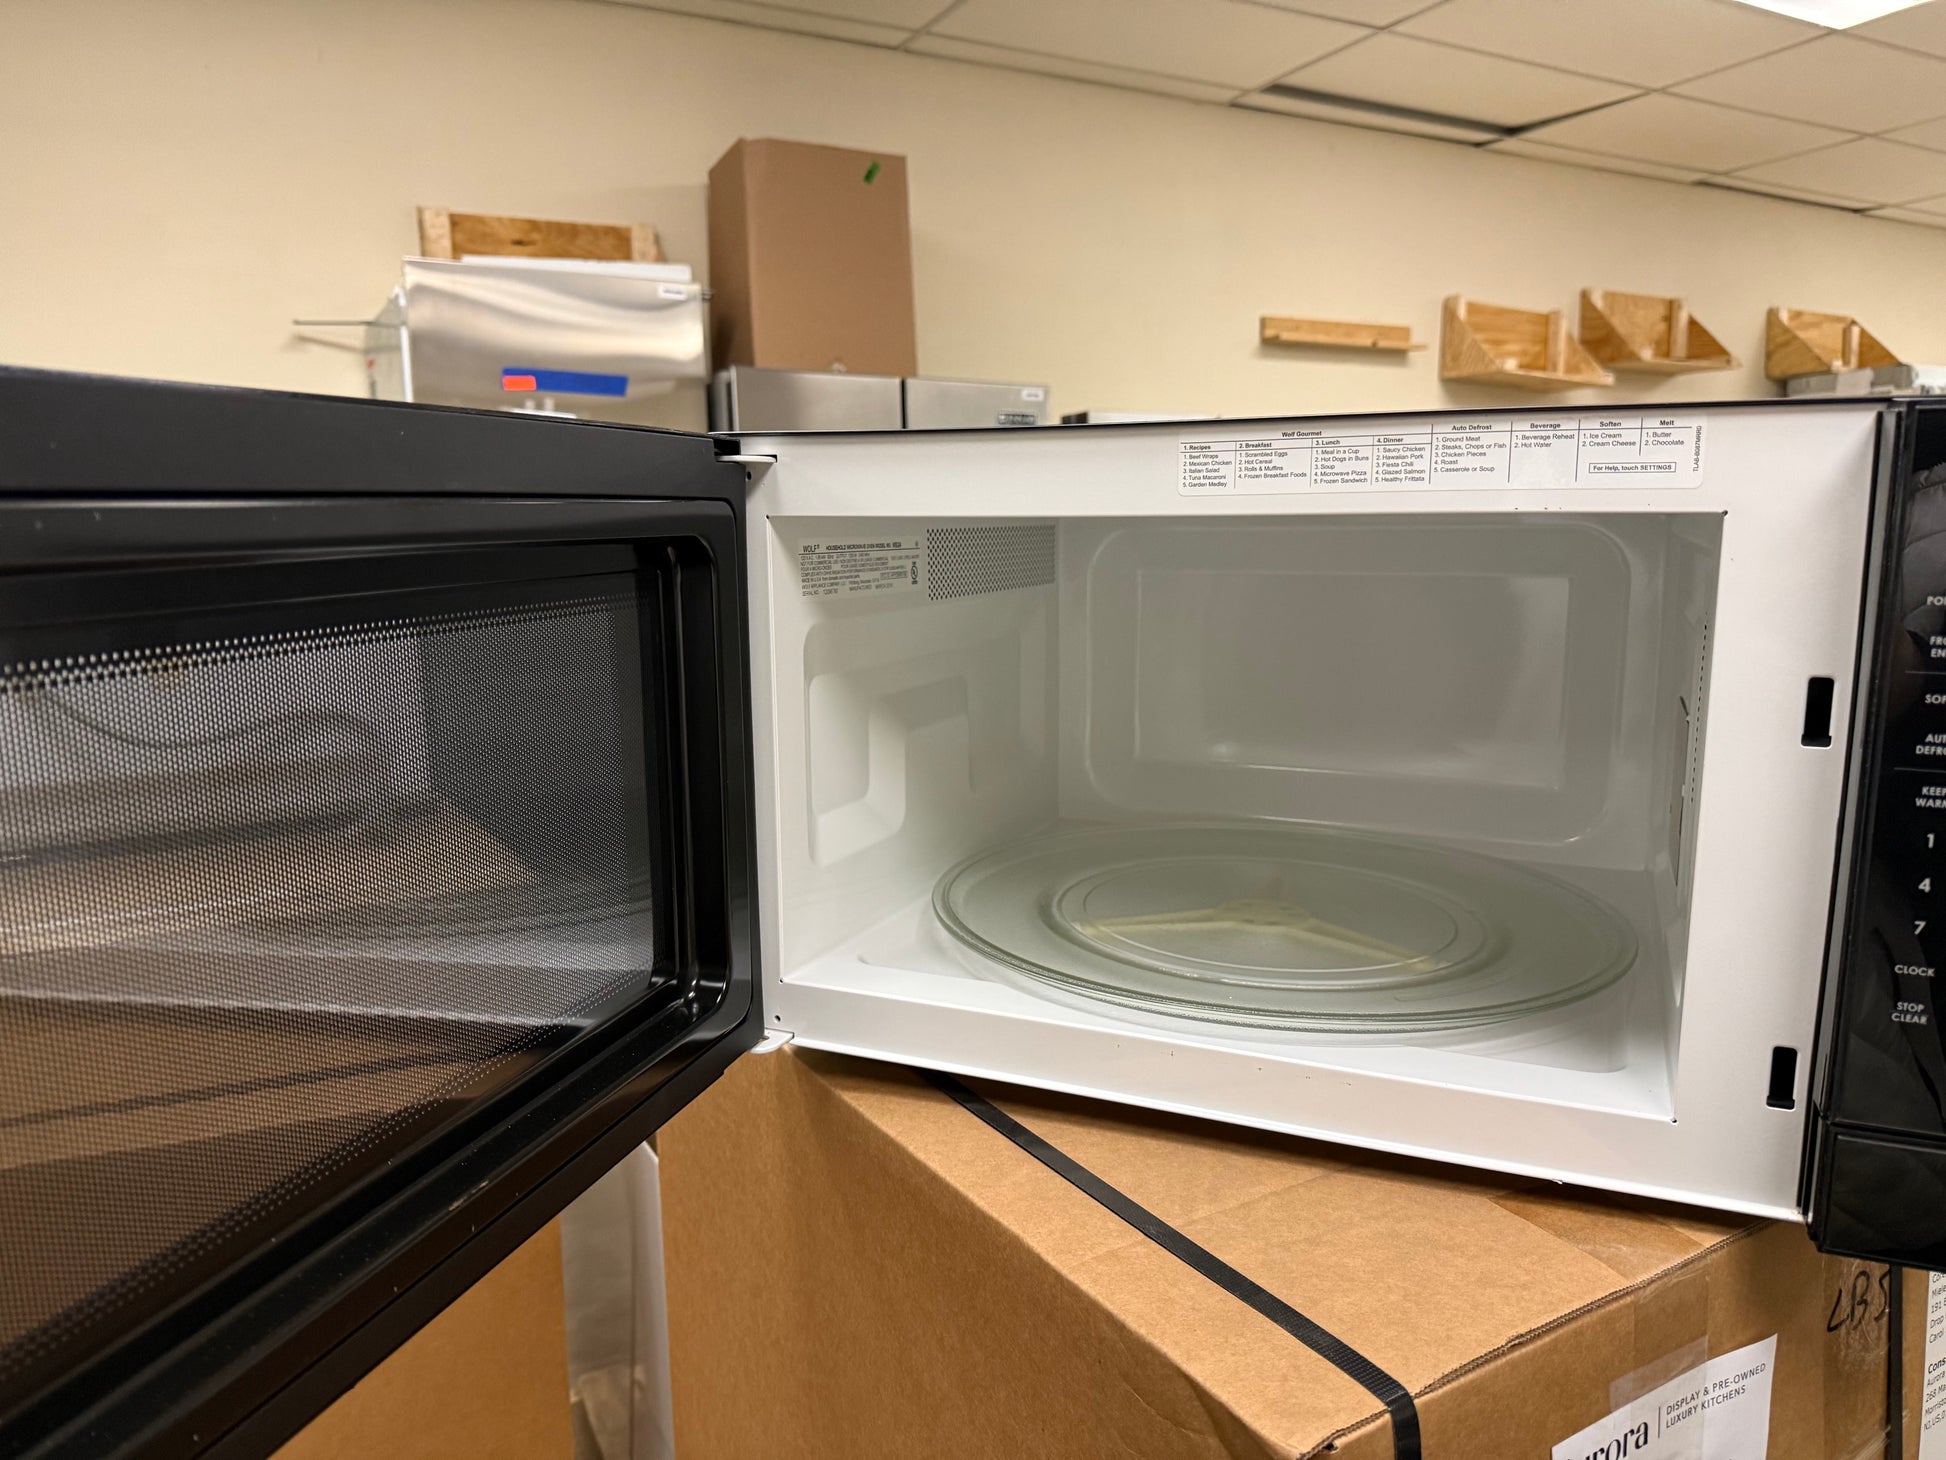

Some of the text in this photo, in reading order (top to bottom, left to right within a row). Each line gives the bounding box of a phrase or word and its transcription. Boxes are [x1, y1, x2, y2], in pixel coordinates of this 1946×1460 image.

[1927, 595, 1946, 606] PO
[1927, 833, 1935, 848] 1
[1918, 878, 1931, 893] 4
[1914, 920, 1926, 935] 7
[1894, 964, 1936, 977] CLOCK
[1896, 1001, 1925, 1013] STOP
[1891, 1012, 1928, 1024] CLEAR
[1667, 1363, 1766, 1415] DISPLAY & PRE-OWNED
[1666, 1385, 1746, 1428] LUXURY KITCHENS
